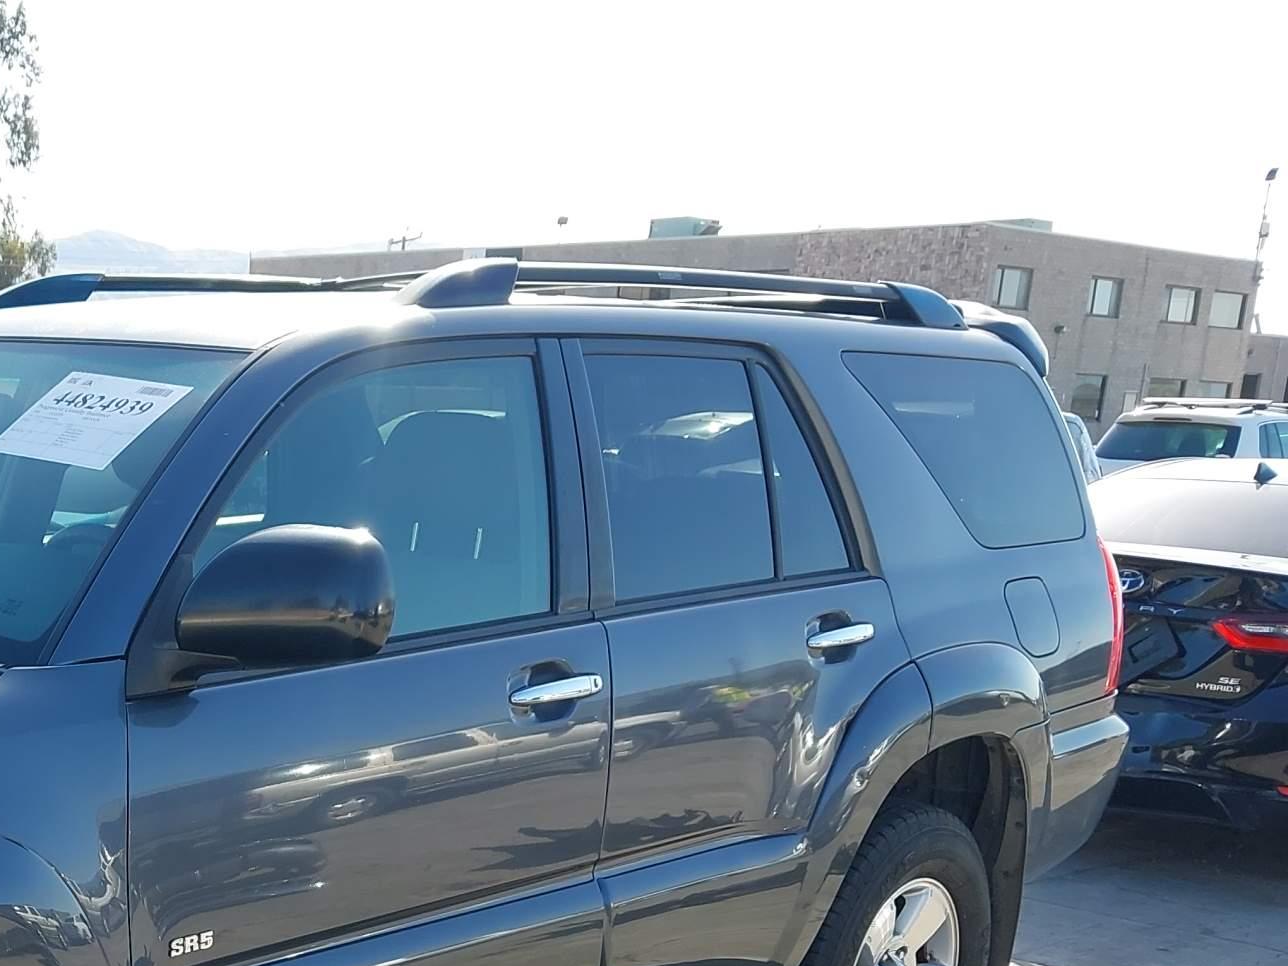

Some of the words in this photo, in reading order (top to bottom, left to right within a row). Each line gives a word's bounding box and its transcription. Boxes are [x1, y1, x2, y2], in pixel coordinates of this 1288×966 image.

[53, 390, 154, 416] 44824939
[1196, 682, 1234, 693] HYBRID
[1218, 676, 1242, 685] SE
[169, 930, 214, 958] SR5
